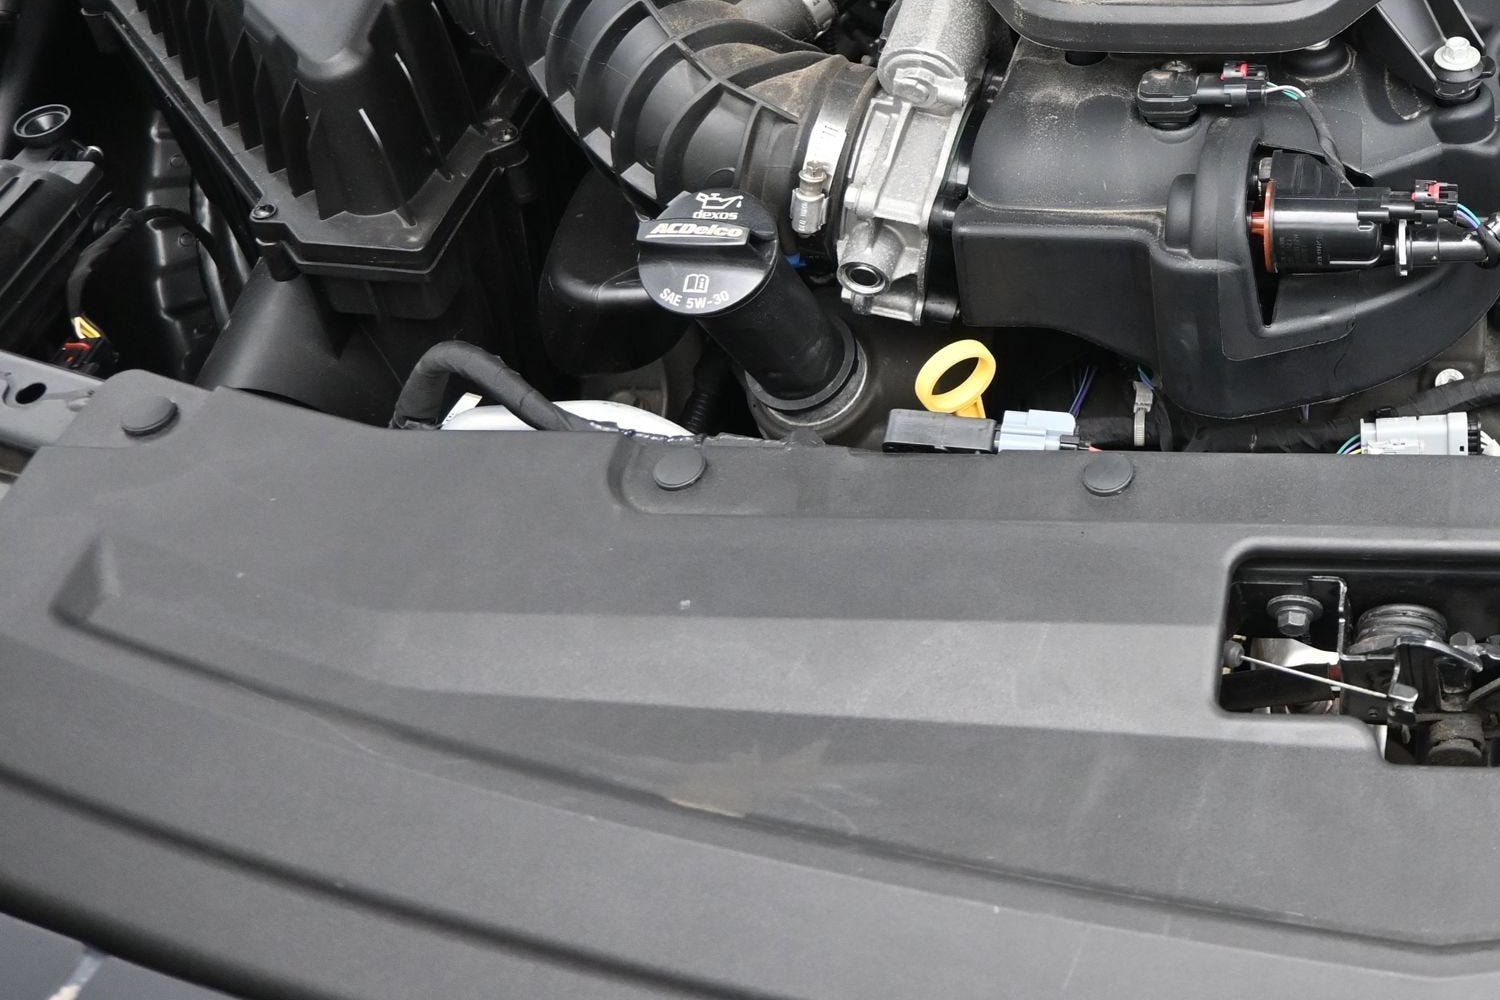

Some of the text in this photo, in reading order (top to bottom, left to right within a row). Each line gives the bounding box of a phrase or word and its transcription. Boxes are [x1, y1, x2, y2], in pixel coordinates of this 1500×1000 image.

[692, 210, 739, 220] dexos
[649, 222, 744, 238] ACDelco
[659, 288, 730, 309] SAE 5W-30
